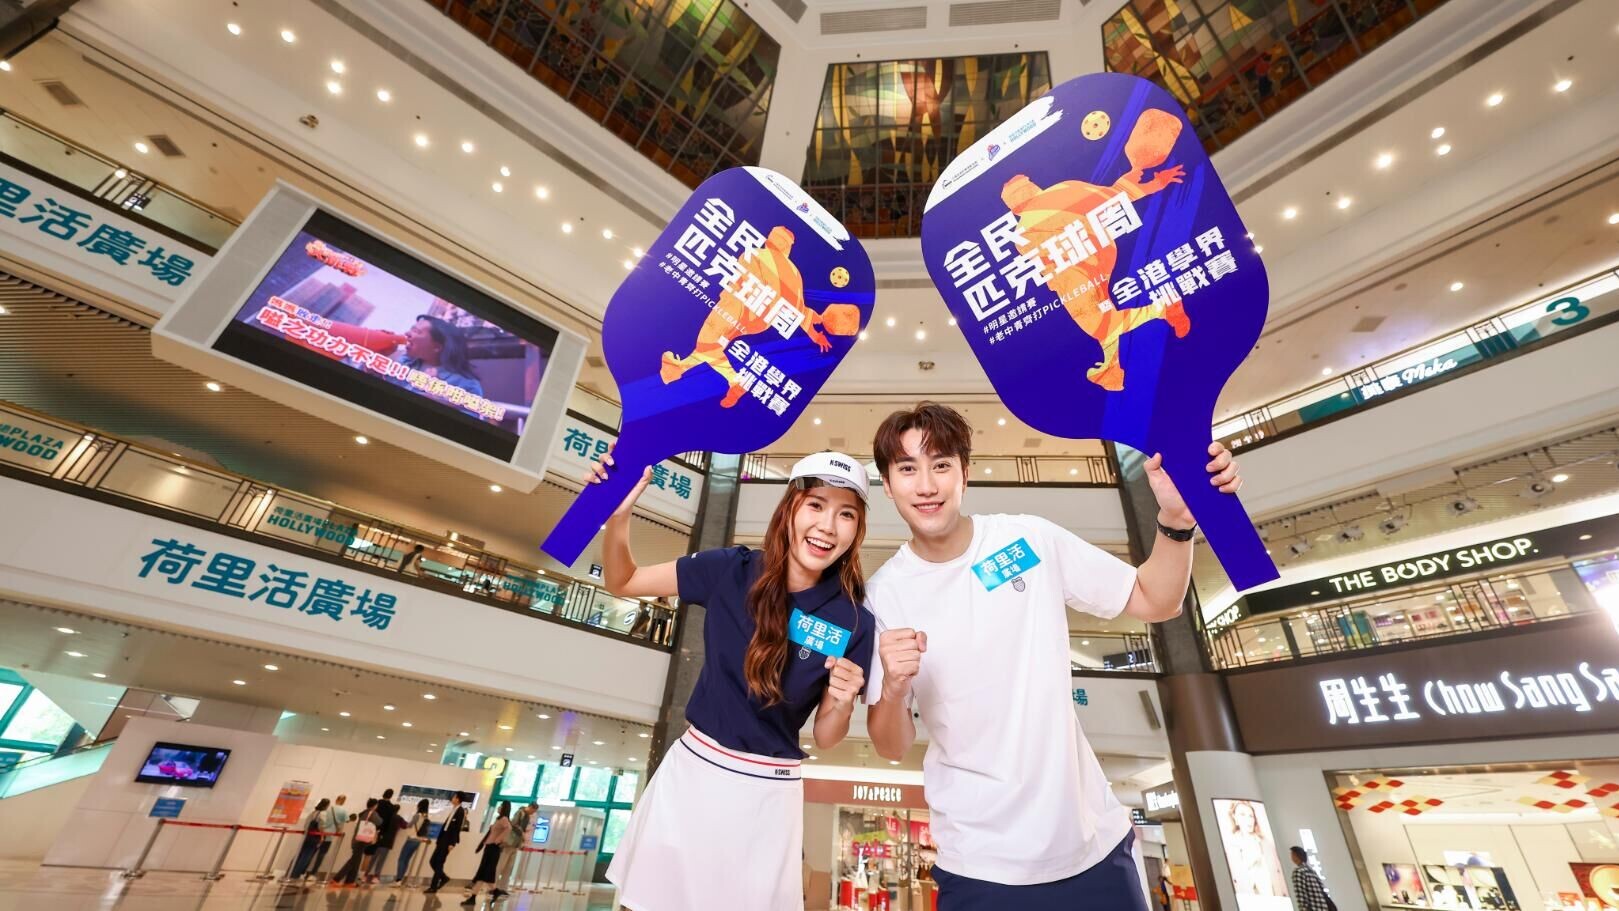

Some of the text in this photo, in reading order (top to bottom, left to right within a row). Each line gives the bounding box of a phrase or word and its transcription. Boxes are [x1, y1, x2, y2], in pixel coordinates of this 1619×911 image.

[0, 177, 195, 287] 里活廣場
[693, 197, 768, 264] 全民
[943, 211, 1032, 288] 全民
[962, 190, 1143, 322] 匹克球周
[673, 223, 806, 340] 匹克球周
[1148, 249, 1239, 313] 挑戰賽
[983, 297, 1037, 334] #明星邀請賽
[1547, 296, 1590, 326] 3
[732, 366, 791, 417] 挑戰賽
[267, 514, 355, 546] HOLLYWOOD
[137, 537, 399, 631] 荷里活廣場
[980, 543, 1026, 576] 荷里活
[1001, 563, 1021, 579] 廣場
[1329, 538, 1539, 593] THE BODY SHOP.
[797, 614, 843, 645] 荷里活
[804, 635, 824, 650] 廣場
[1319, 672, 1421, 725] 周生生
[1423, 679, 1506, 716] Chow
[1500, 670, 1593, 712] Sang
